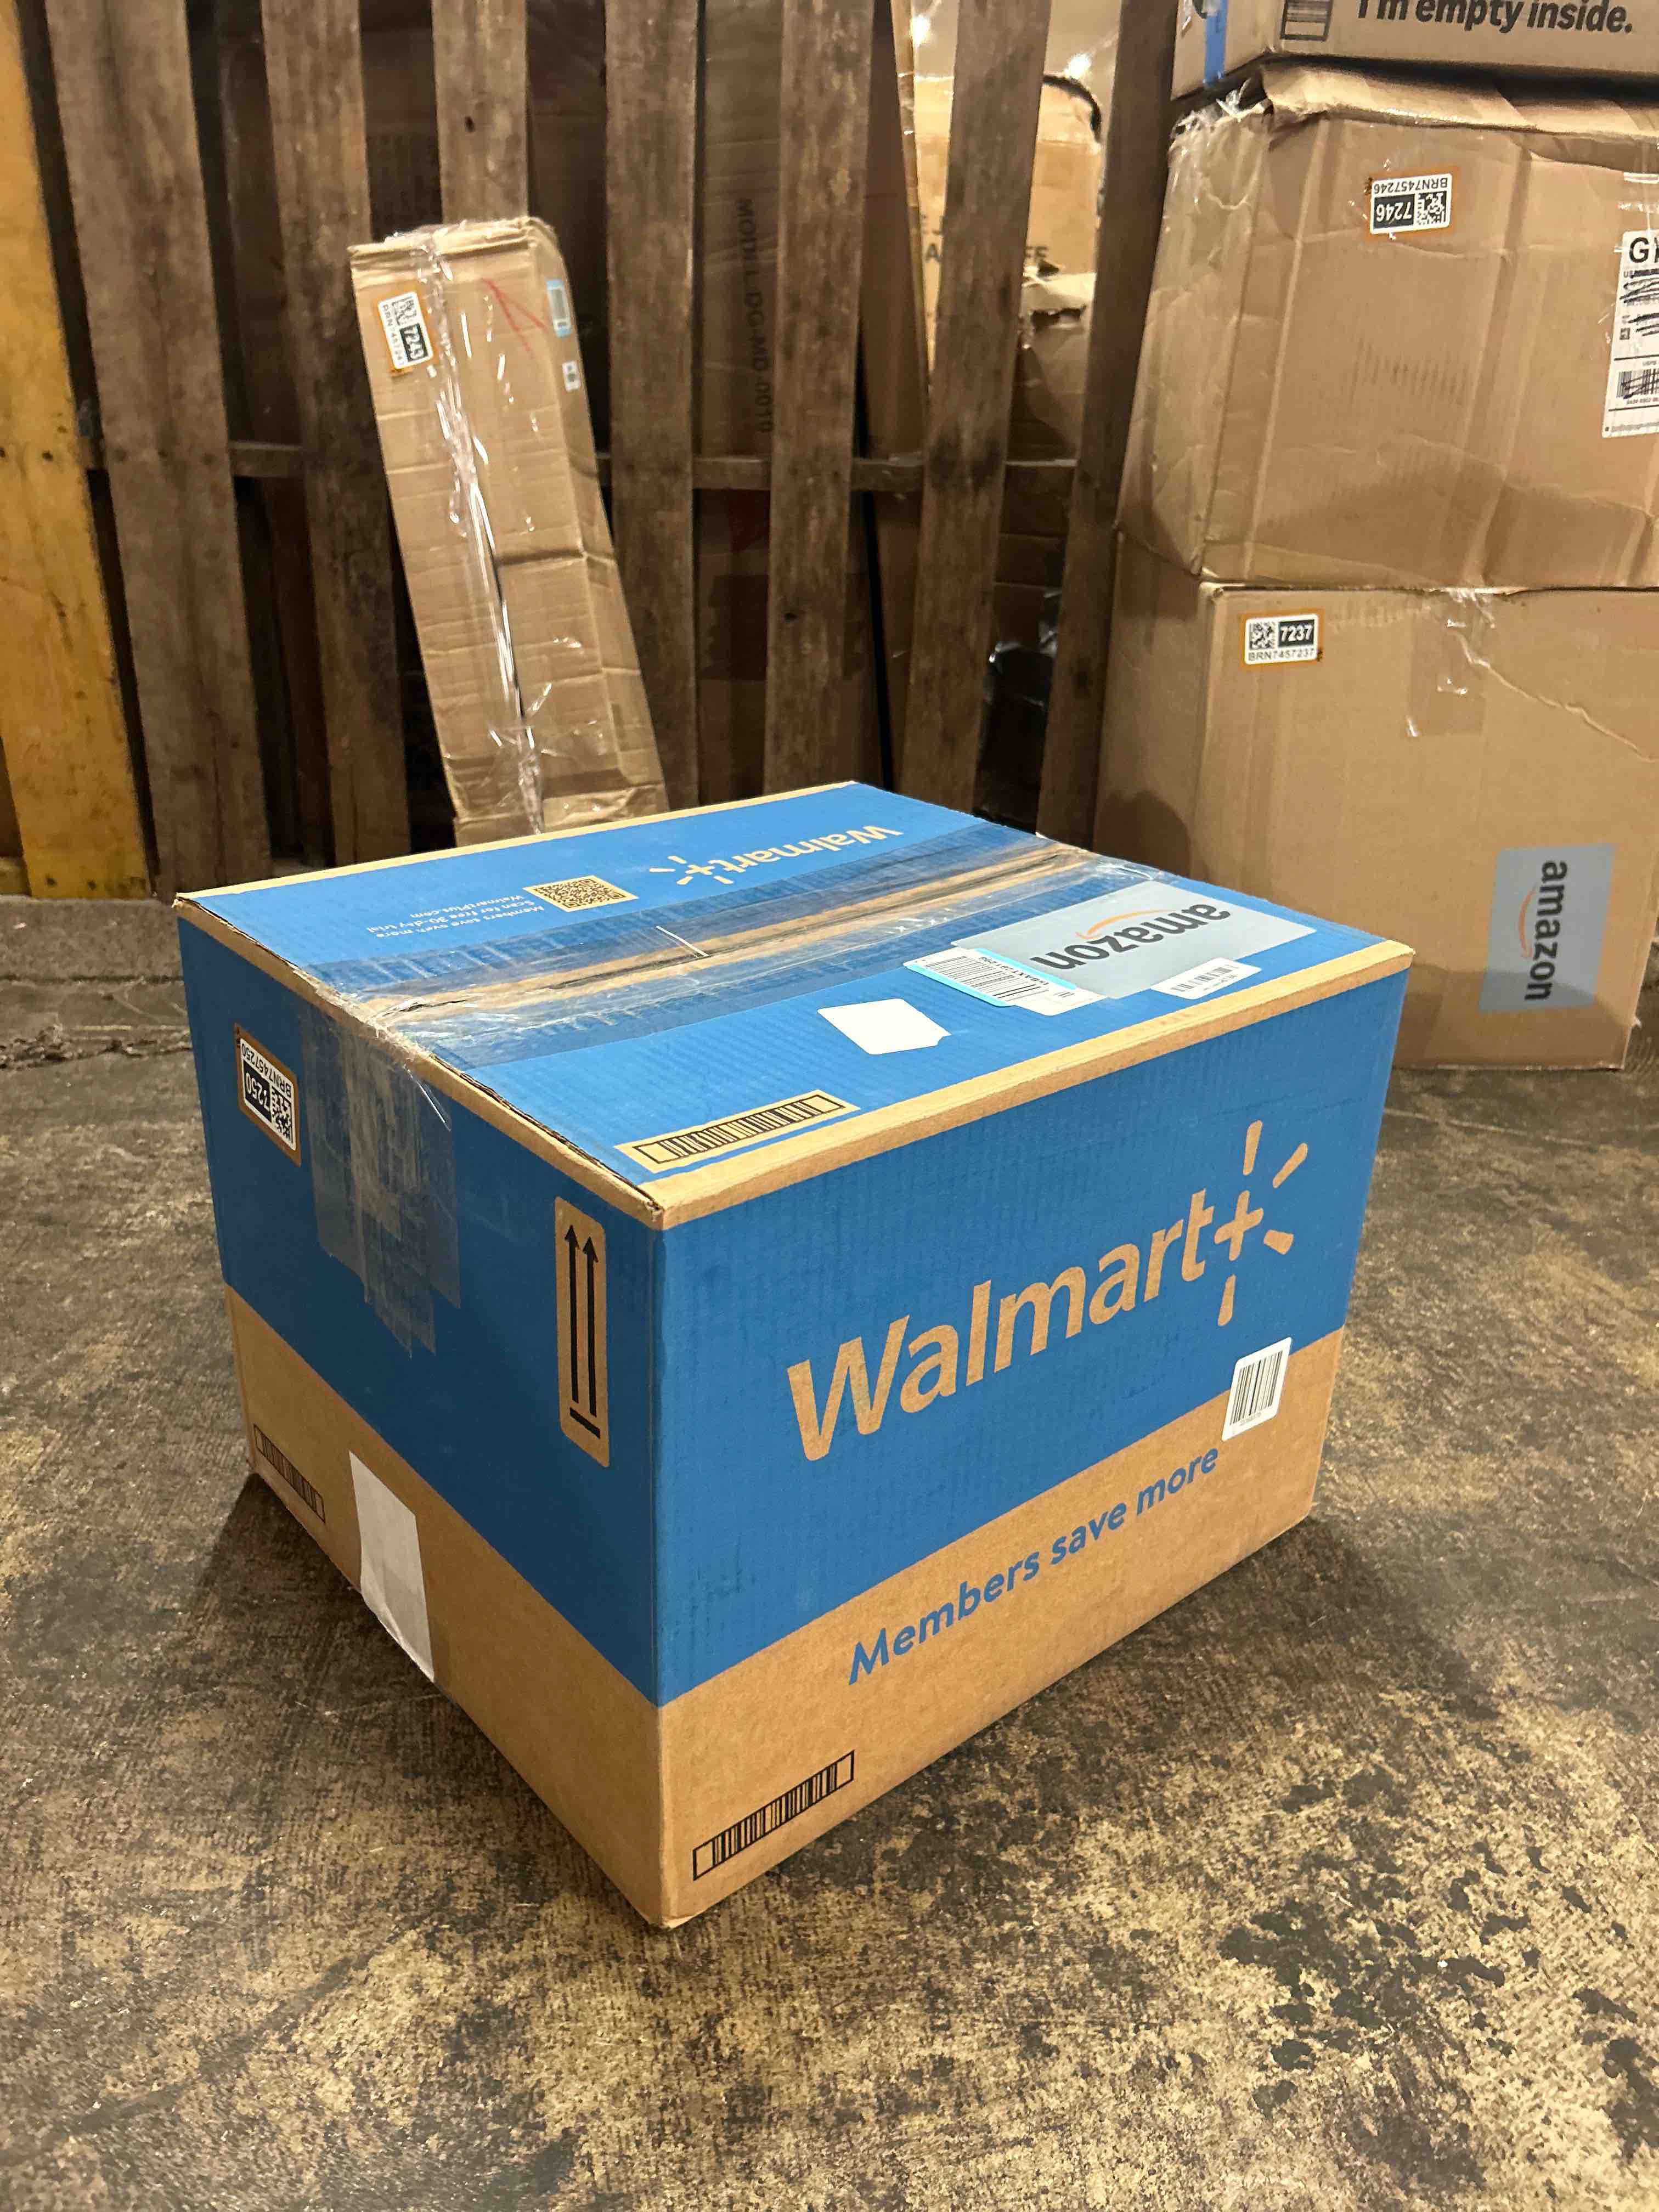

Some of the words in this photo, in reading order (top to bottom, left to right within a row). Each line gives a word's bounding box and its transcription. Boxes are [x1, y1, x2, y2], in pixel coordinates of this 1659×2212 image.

[1358, 0, 1408, 20] Im
[1415, 0, 1523, 33] empty
[1527, 0, 1633, 33] inside.
[1373, 177, 1448, 194] BRN7457246
[1376, 201, 1412, 222] 7246
[1280, 624, 1313, 642] 7237
[1248, 648, 1315, 661] BRN7457237
[482, 905, 545, 921] Members
[501, 900, 535, 909] Scan
[399, 917, 449, 928] 30-day
[448, 910, 478, 919] free
[450, 917, 481, 927] save
[366, 924, 397, 933] trial
[376, 929, 413, 938] more
[1030, 904, 1231, 969] amazon
[1524, 860, 1568, 1001] amazon
[241, 1043, 291, 1097] BRN7457250
[246, 1072, 271, 1112] 7250
[848, 1550, 1040, 1686] Members
[1049, 1502, 1127, 1566] save
[1136, 1448, 1218, 1516] more
